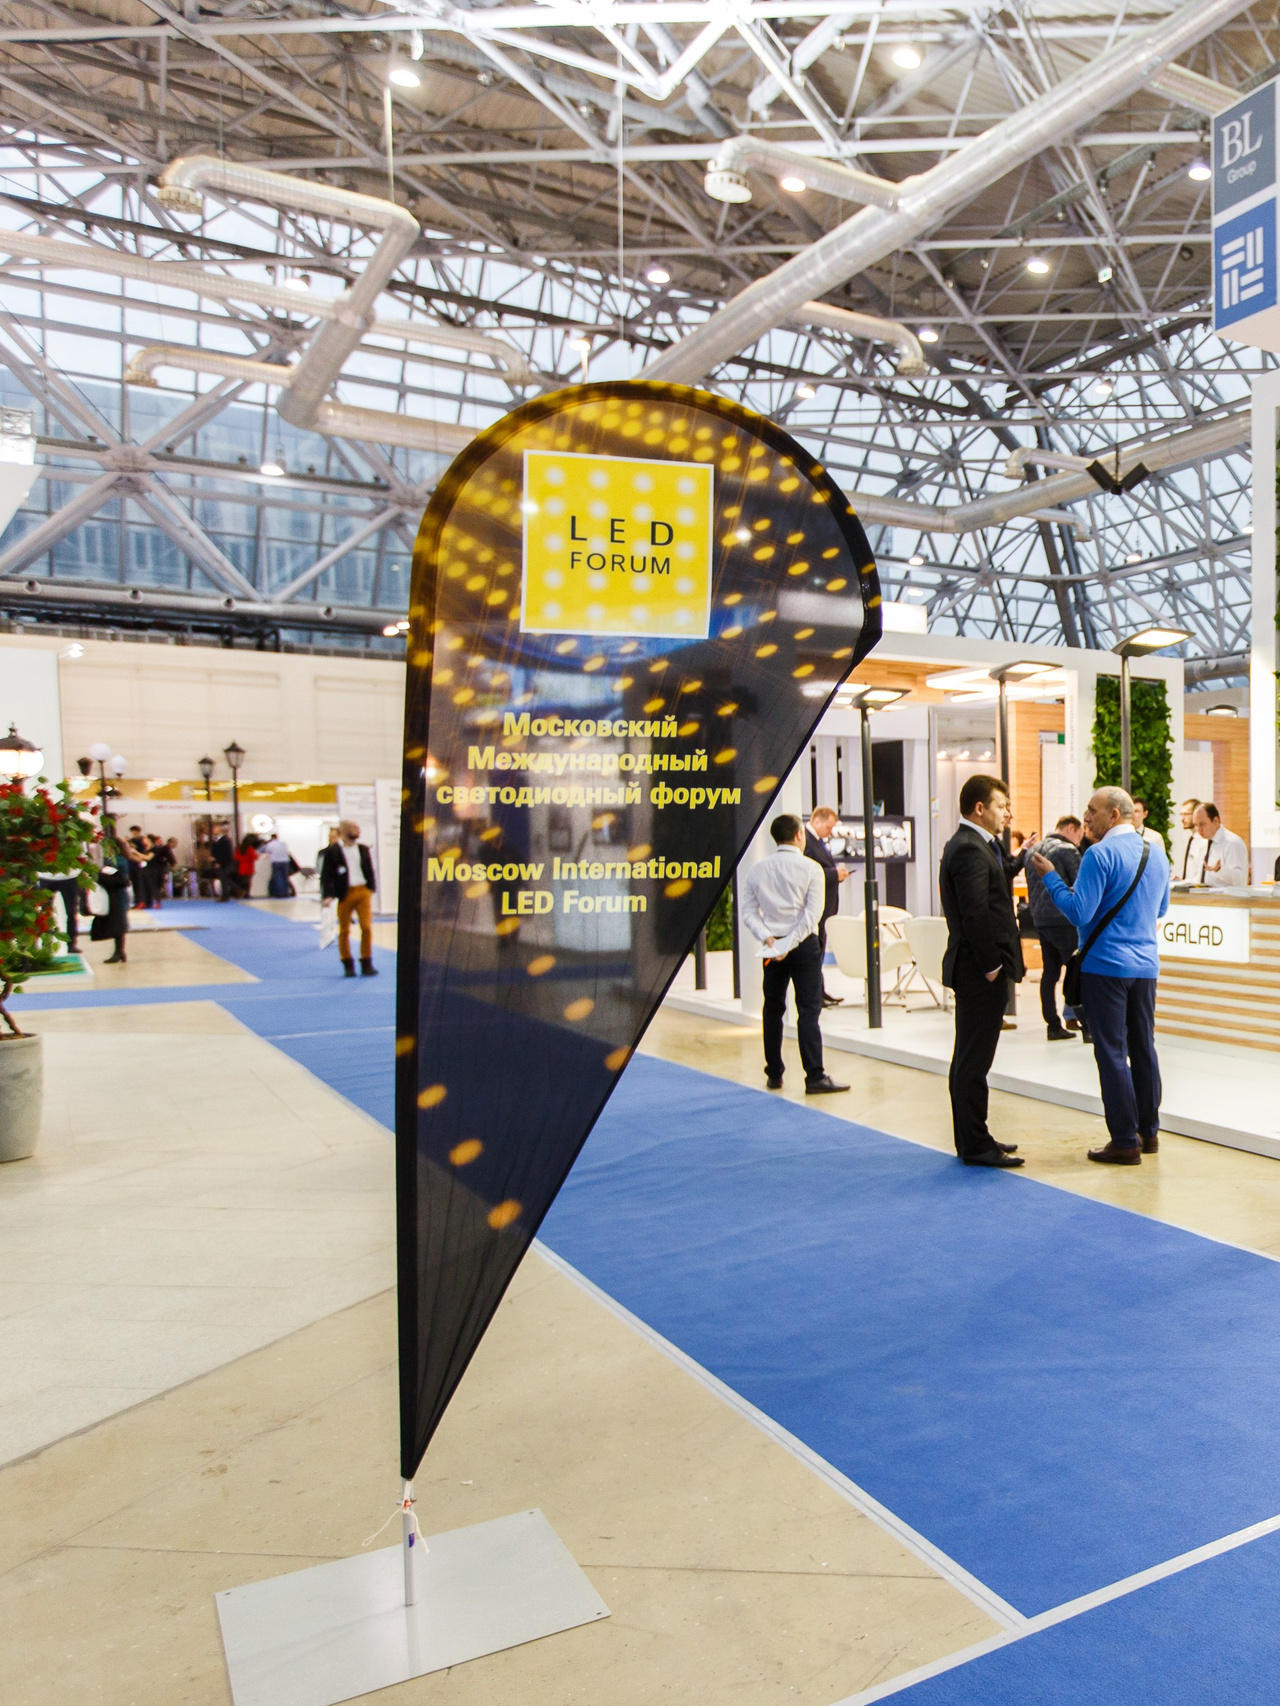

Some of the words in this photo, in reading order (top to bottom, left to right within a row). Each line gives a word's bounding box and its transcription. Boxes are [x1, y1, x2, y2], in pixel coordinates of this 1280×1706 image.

[1221, 111, 1263, 169] BL
[1226, 160, 1257, 184] Group
[570, 515, 674, 546] LED
[570, 551, 670, 575] FORUM
[503, 712, 678, 738] Московский
[467, 745, 708, 775] Международный
[436, 782, 642, 808] светодиодный
[650, 782, 741, 810] форум
[427, 857, 544, 882] Moscow
[552, 856, 721, 880] International
[501, 891, 554, 915] LED
[563, 890, 647, 913] Forum
[1163, 922, 1224, 947] GALAD
